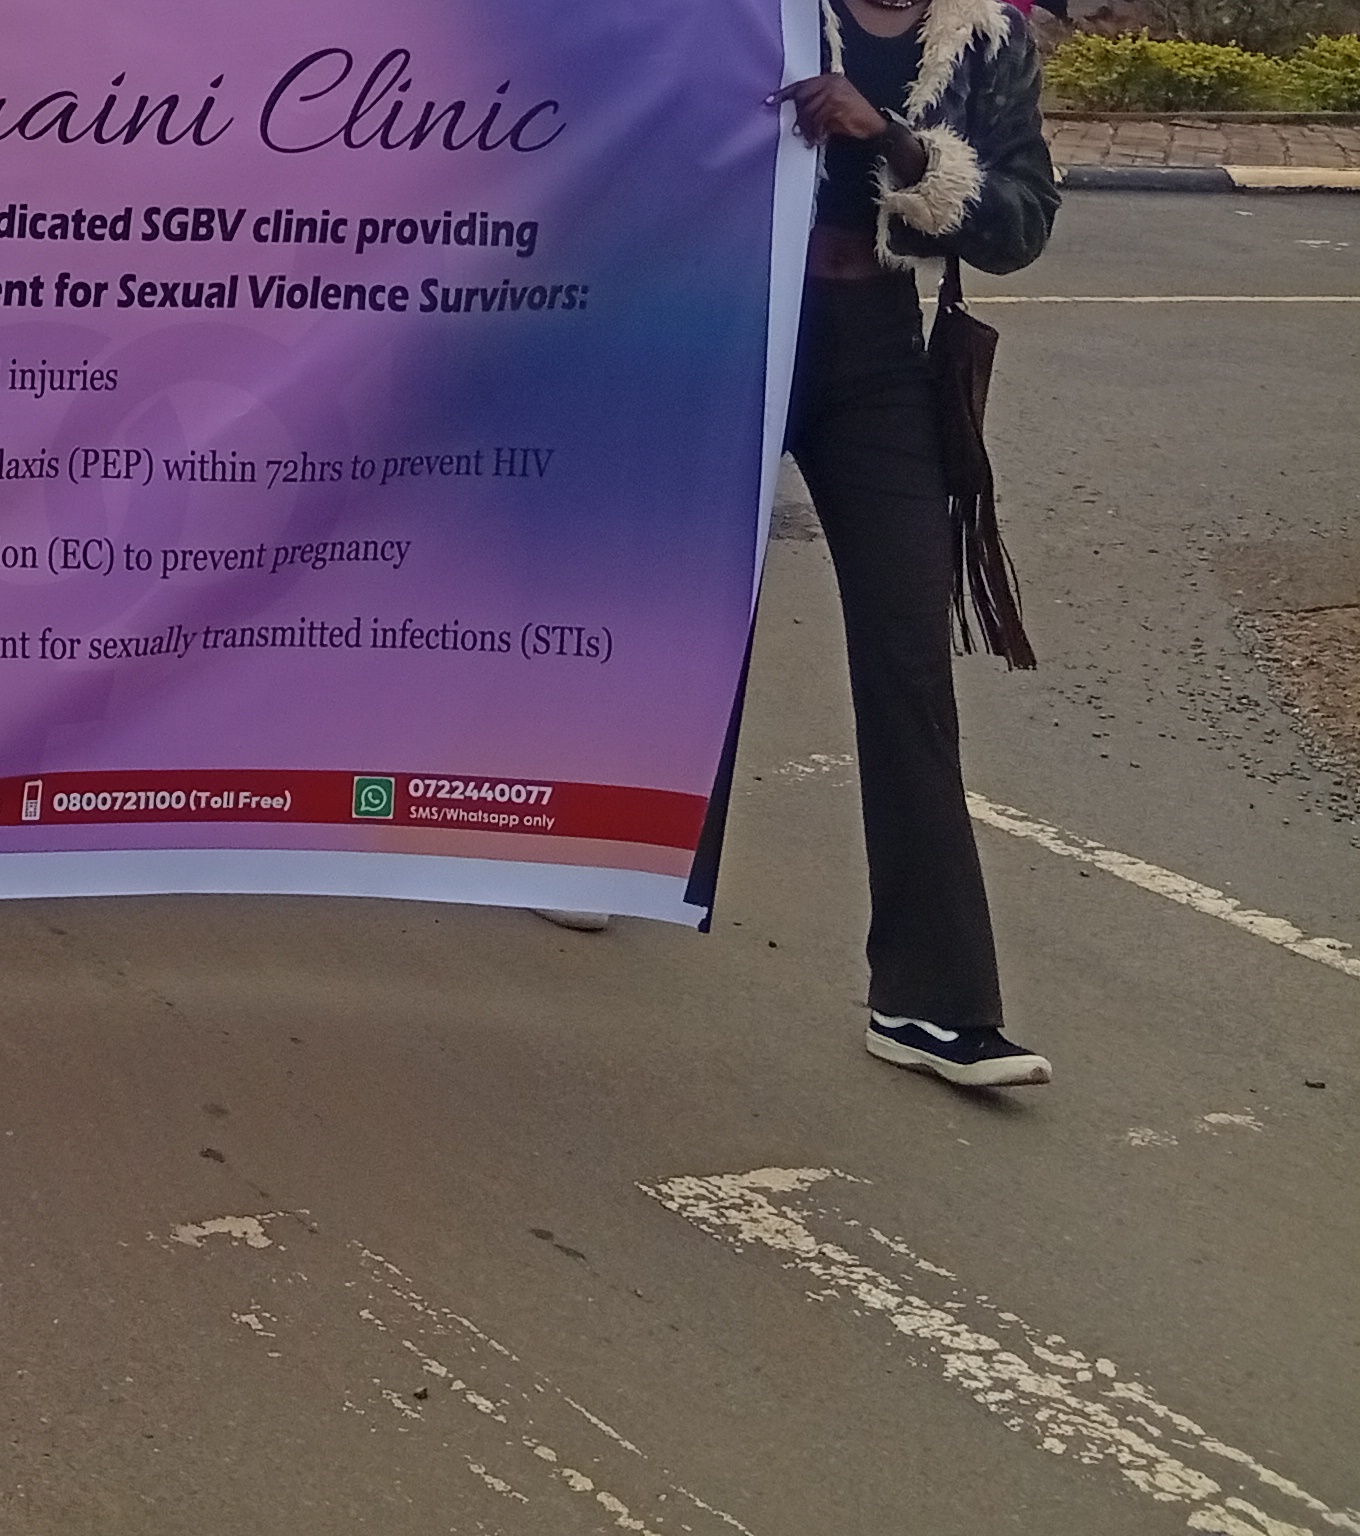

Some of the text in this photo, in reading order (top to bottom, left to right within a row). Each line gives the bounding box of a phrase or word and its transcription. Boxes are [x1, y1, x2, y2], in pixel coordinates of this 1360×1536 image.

[259, 47, 566, 154] Clinic
[140, 206, 247, 245] SGBV
[252, 208, 348, 246] clinic
[355, 210, 539, 258] providing
[55, 270, 108, 309] for
[117, 273, 237, 310] Sexual
[247, 274, 409, 314] Violence
[420, 277, 590, 314] Survivors:
[8, 357, 118, 399] injuries
[68, 446, 153, 485] (PEP)
[163, 450, 256, 483] within
[266, 451, 343, 489] 72hrs
[350, 452, 376, 480] to
[380, 447, 483, 485] prevent
[492, 447, 555, 477] HIV
[48, 538, 115, 576] (EC)
[123, 544, 152, 571] to
[161, 541, 265, 579] prevent
[270, 536, 412, 574] pregnancy
[38, 628, 81, 661] for
[88, 625, 197, 661] sexually
[201, 616, 363, 650] transmitted
[369, 618, 511, 654] infections
[520, 622, 613, 664] (STIs)
[408, 778, 553, 805] 0722440077
[523, 812, 555, 831] only
